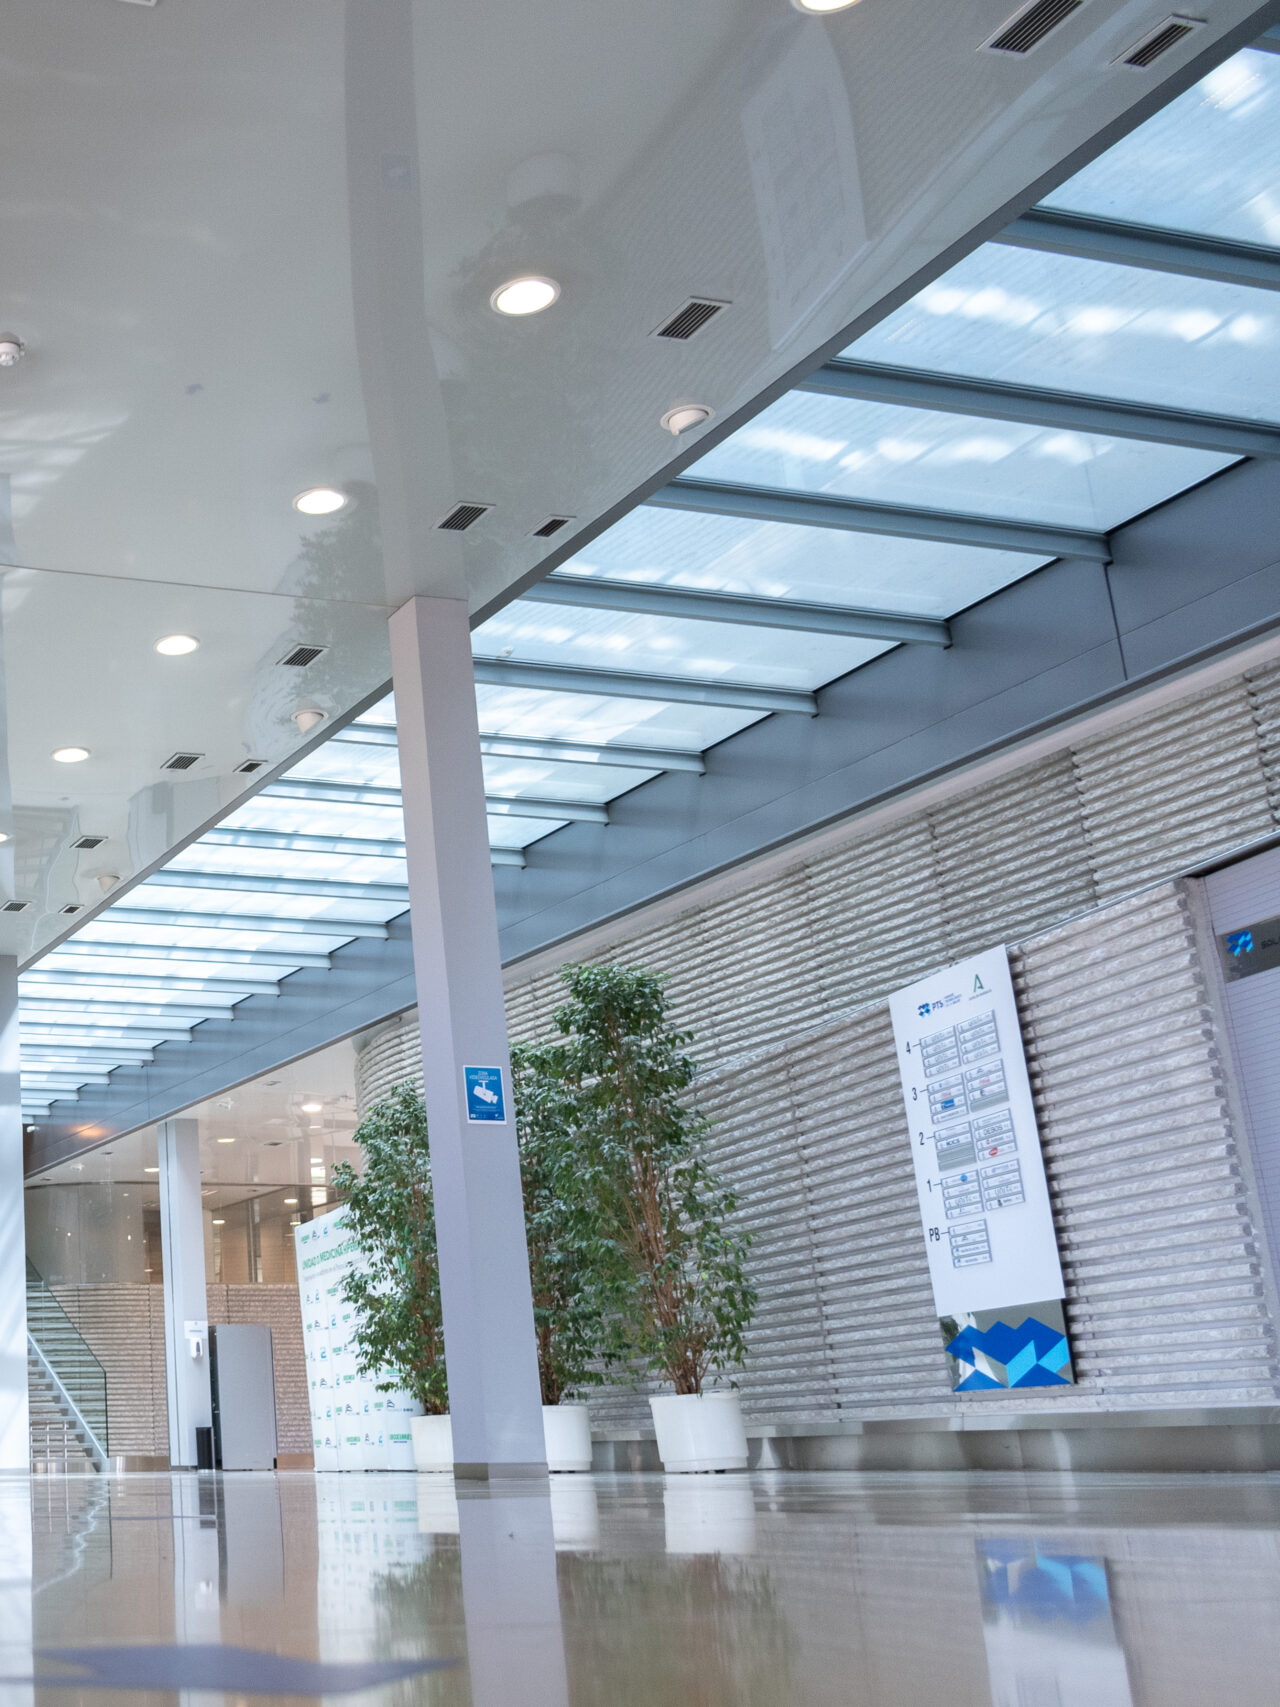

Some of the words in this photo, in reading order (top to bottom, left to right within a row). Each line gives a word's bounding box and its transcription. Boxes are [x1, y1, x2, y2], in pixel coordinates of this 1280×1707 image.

[906, 1041, 911, 1054] 4
[911, 1087, 918, 1101] 3
[919, 1132, 925, 1145] 2
[926, 1179, 932, 1192] 1
[929, 1228, 941, 1242] PB
